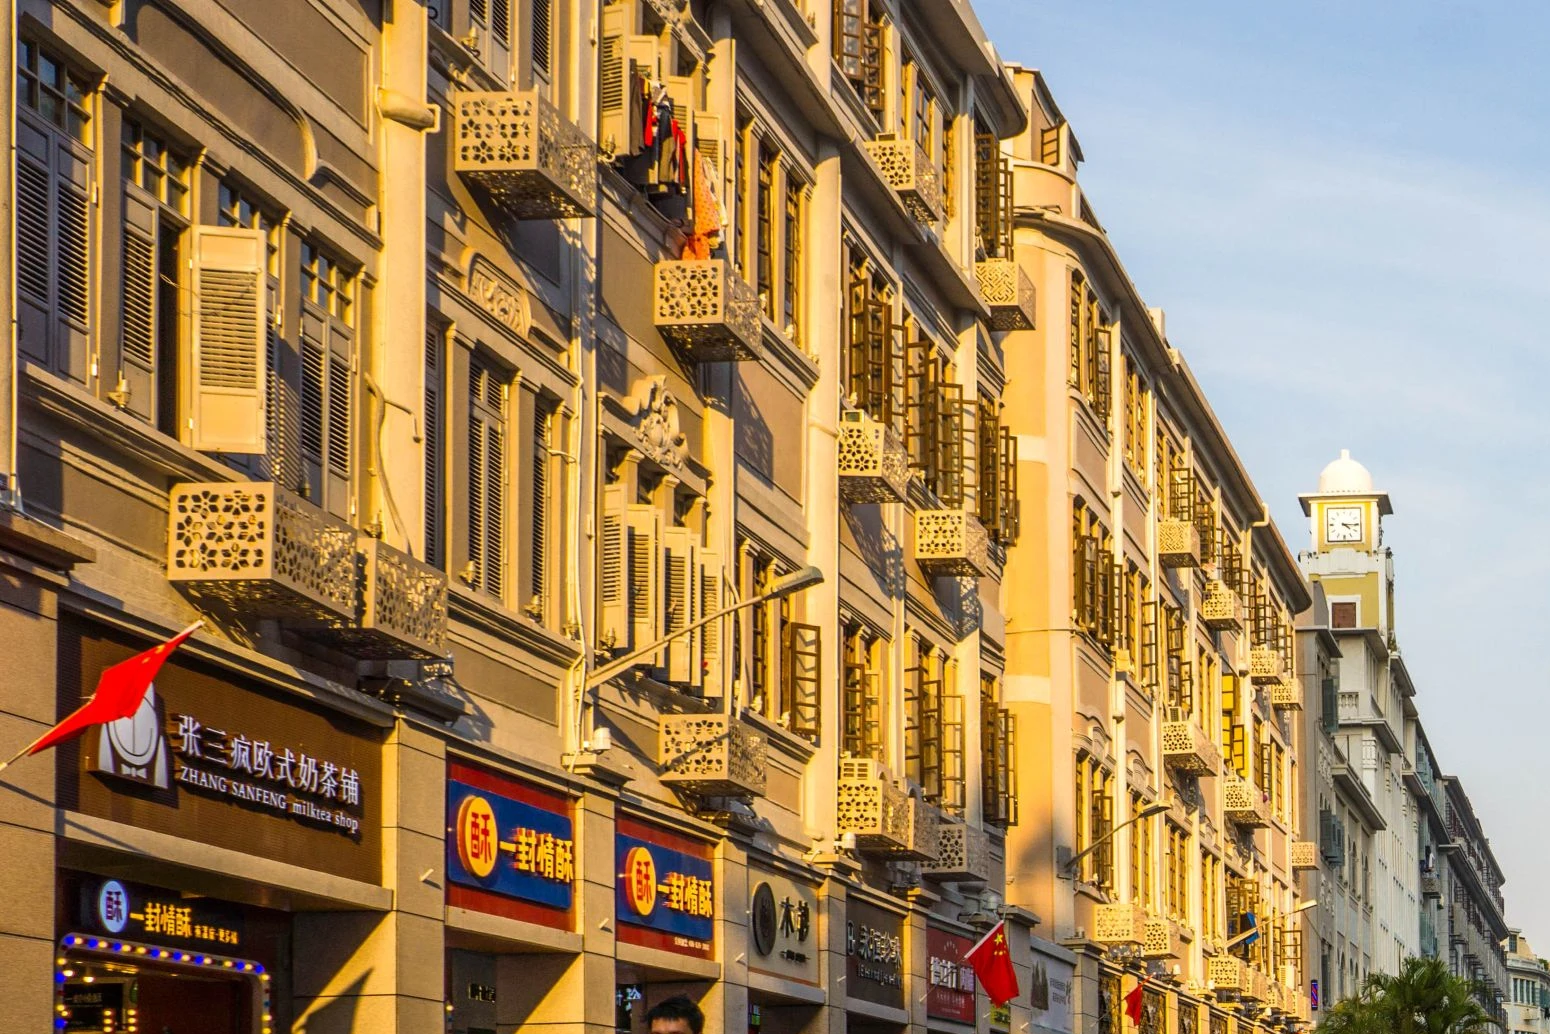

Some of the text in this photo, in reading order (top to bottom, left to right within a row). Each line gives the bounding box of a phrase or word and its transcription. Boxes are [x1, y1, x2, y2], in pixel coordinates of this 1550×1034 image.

[178, 714, 359, 806] 张三疯欧式奶茶铺
[180, 766, 359, 835] ZHANG SANFENG milktea shop
[470, 811, 574, 884] 酥 一封情酥
[105, 890, 193, 938] 酥 一封情酥
[635, 860, 712, 918] 酥 一封情酥
